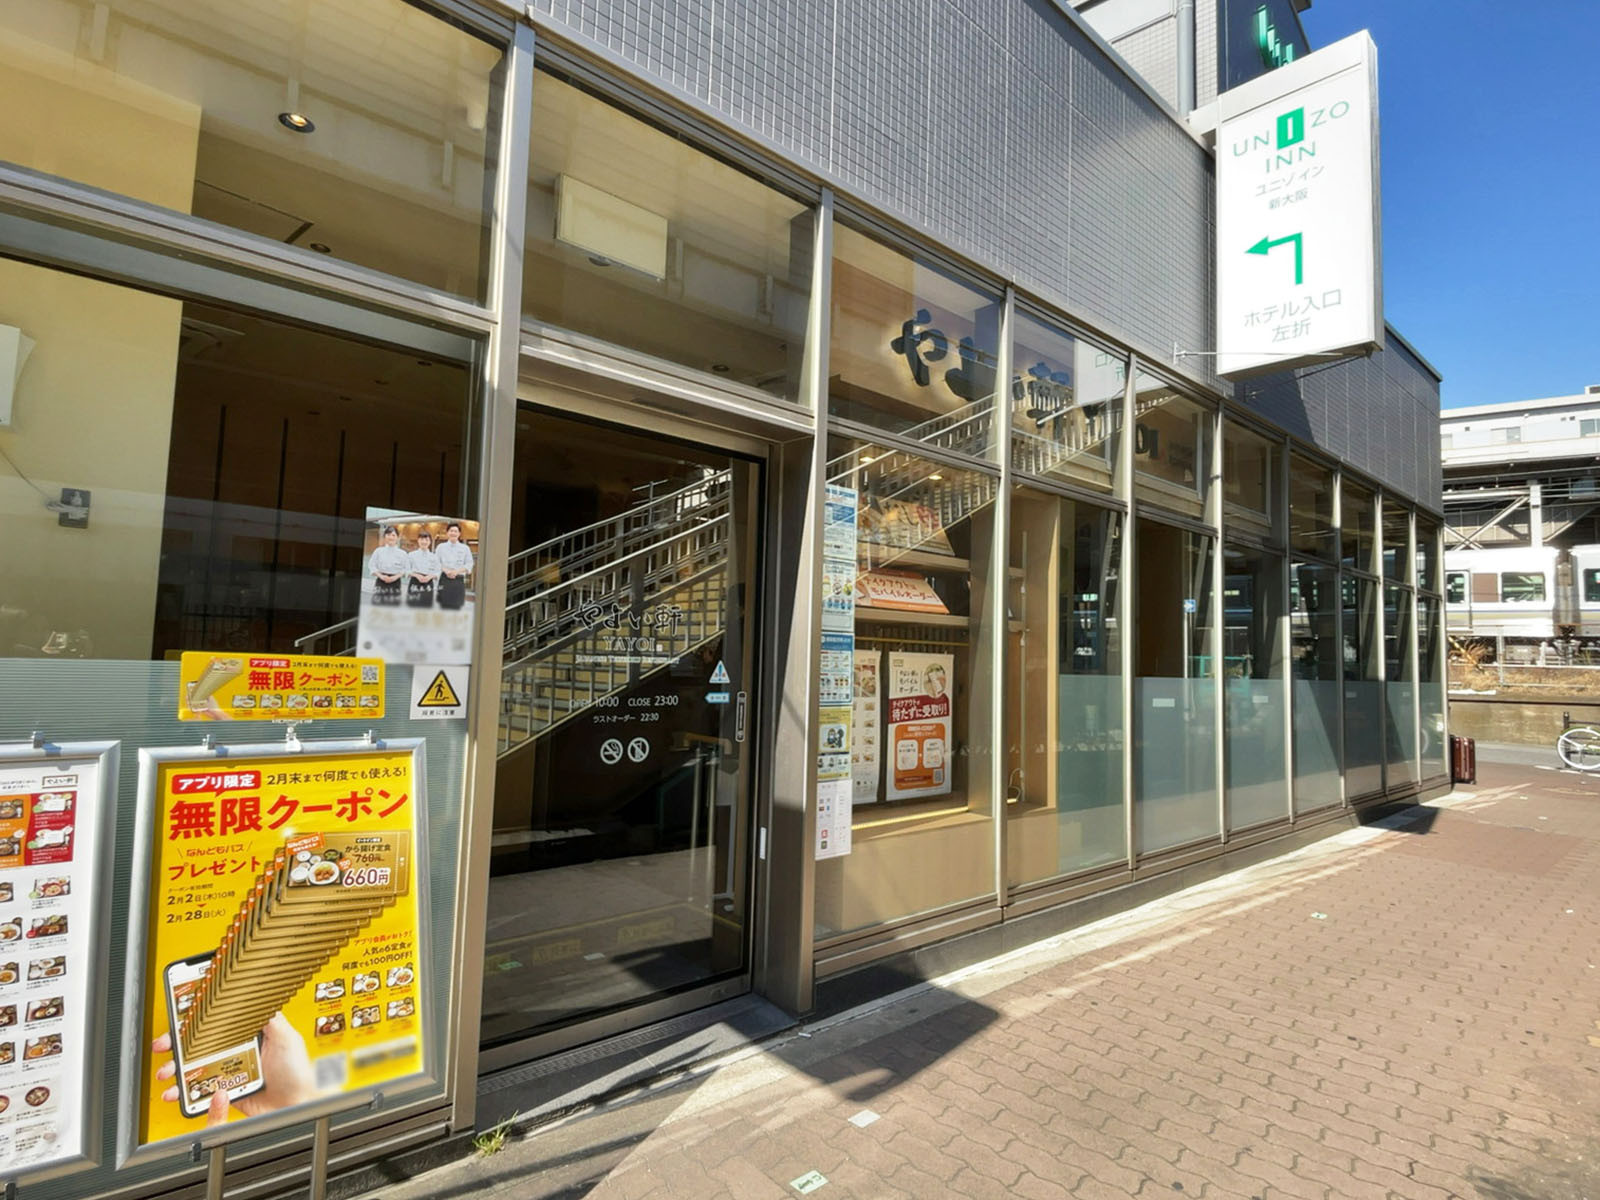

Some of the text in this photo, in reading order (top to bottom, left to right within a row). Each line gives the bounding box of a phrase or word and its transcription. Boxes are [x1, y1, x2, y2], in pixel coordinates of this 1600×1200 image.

[1233, 101, 1350, 157] UNIZO
[1266, 141, 1317, 173] INN
[1269, 188, 1309, 210] 新大阪
[1244, 288, 1342, 327] ホテル入口
[1271, 317, 1312, 343] 左折
[573, 600, 683, 637] やよい軒
[603, 636, 656, 652] YAYOI
[627, 697, 651, 707] CLOSE
[654, 695, 679, 706] 23:00
[640, 713, 659, 722] 22:30
[178, 774, 256, 791] アプリ限定
[168, 787, 409, 841] 無限クーポン
[168, 856, 261, 881] プレゼント
[344, 868, 389, 886] 660円
